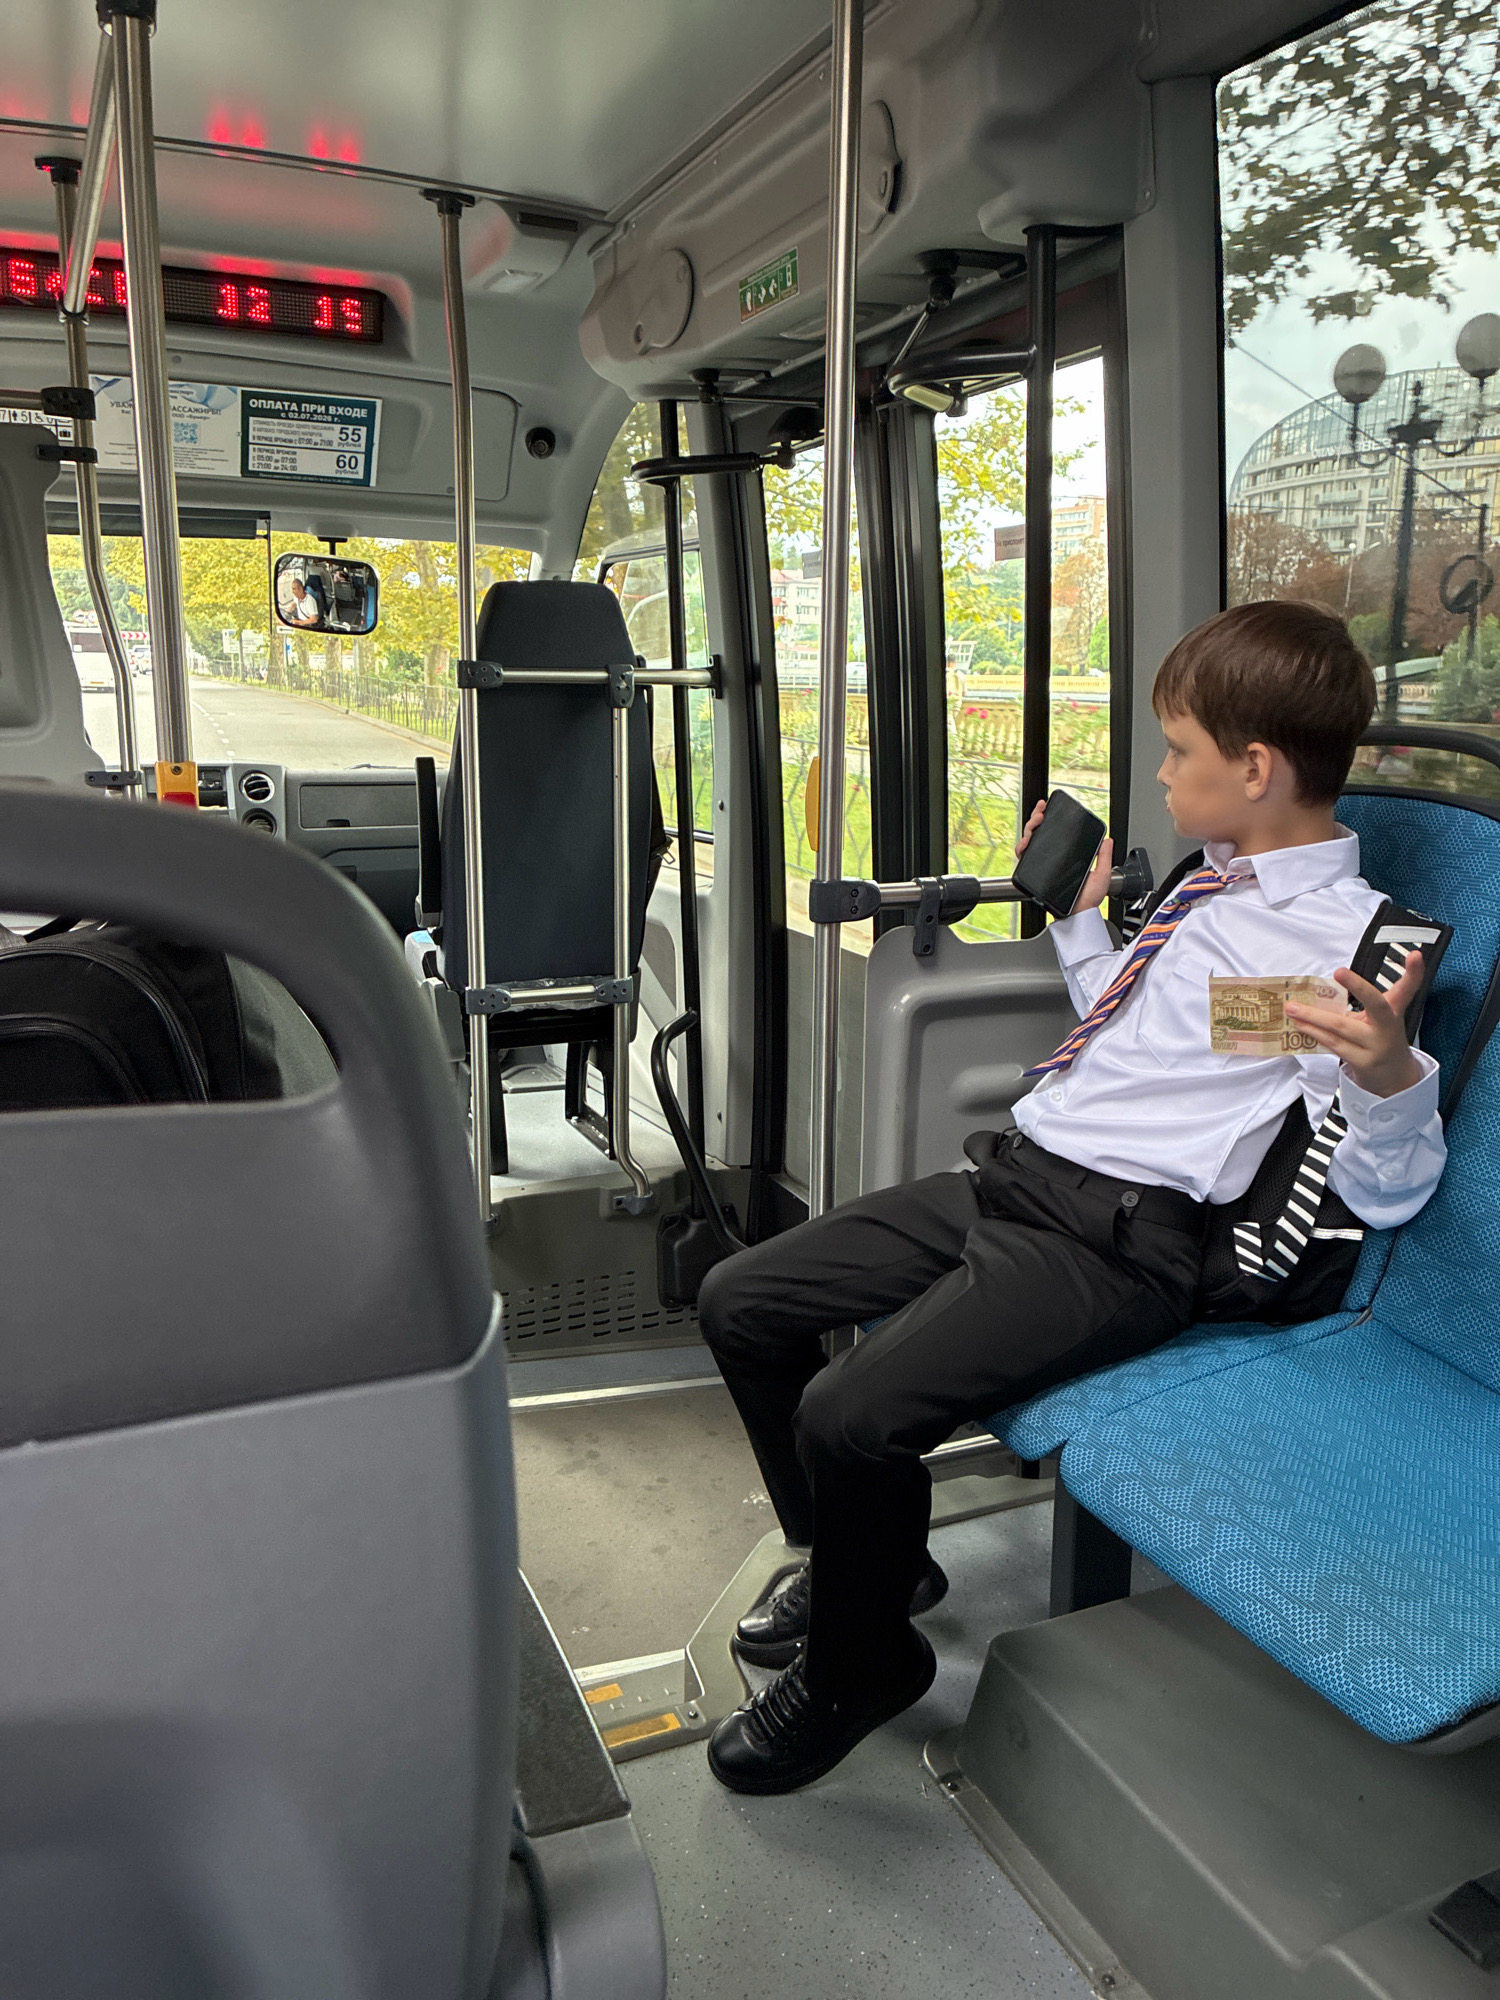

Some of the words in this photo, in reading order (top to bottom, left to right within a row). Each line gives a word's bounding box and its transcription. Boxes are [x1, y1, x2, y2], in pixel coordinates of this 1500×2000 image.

[248, 398, 299, 412] ОПЛАТА
[301, 403, 326, 414] ПРИ
[328, 405, 368, 419] ВХОДЕ
[21, 410, 28, 423] 5
[338, 427, 361, 442] 55
[336, 454, 358, 469] 60
